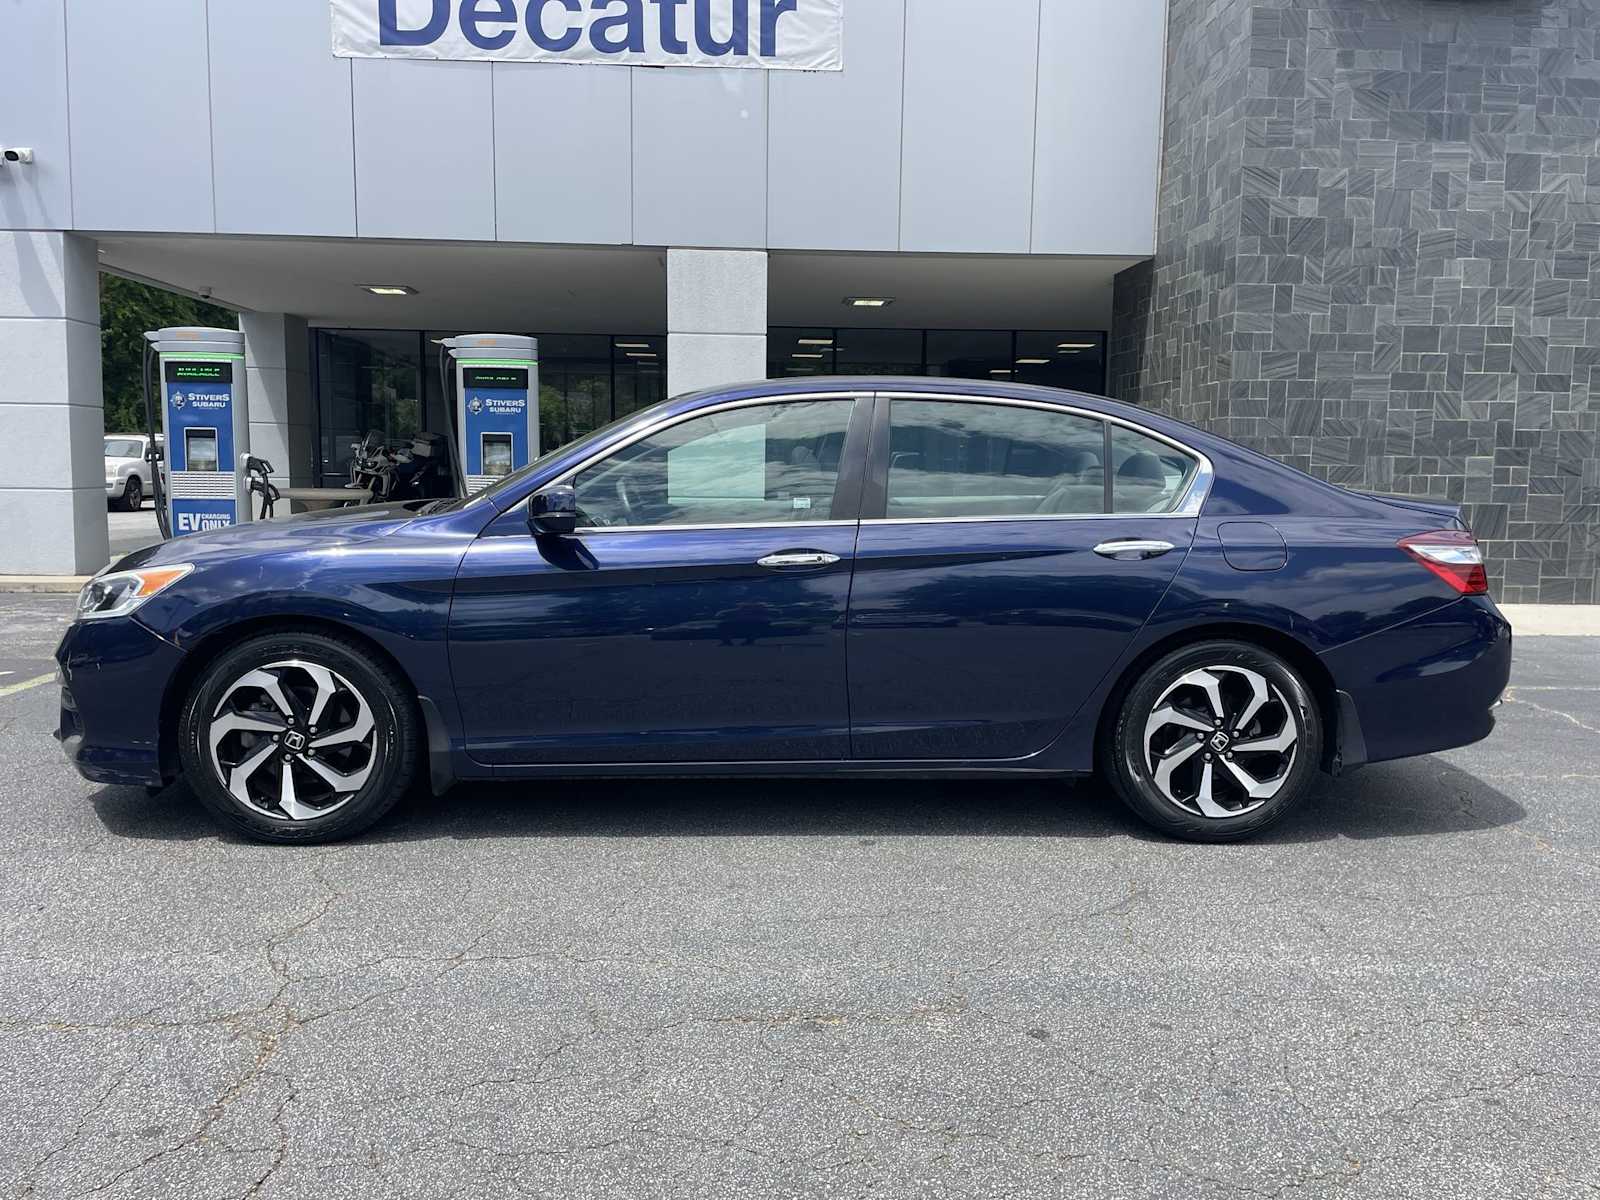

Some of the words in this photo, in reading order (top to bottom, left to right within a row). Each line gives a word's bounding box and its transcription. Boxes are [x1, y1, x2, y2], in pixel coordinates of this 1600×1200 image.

[378, 0, 797, 57] Decatur
[188, 392, 230, 401] STIVERS
[485, 398, 526, 407] STIVERS
[178, 512, 201, 531] EV
